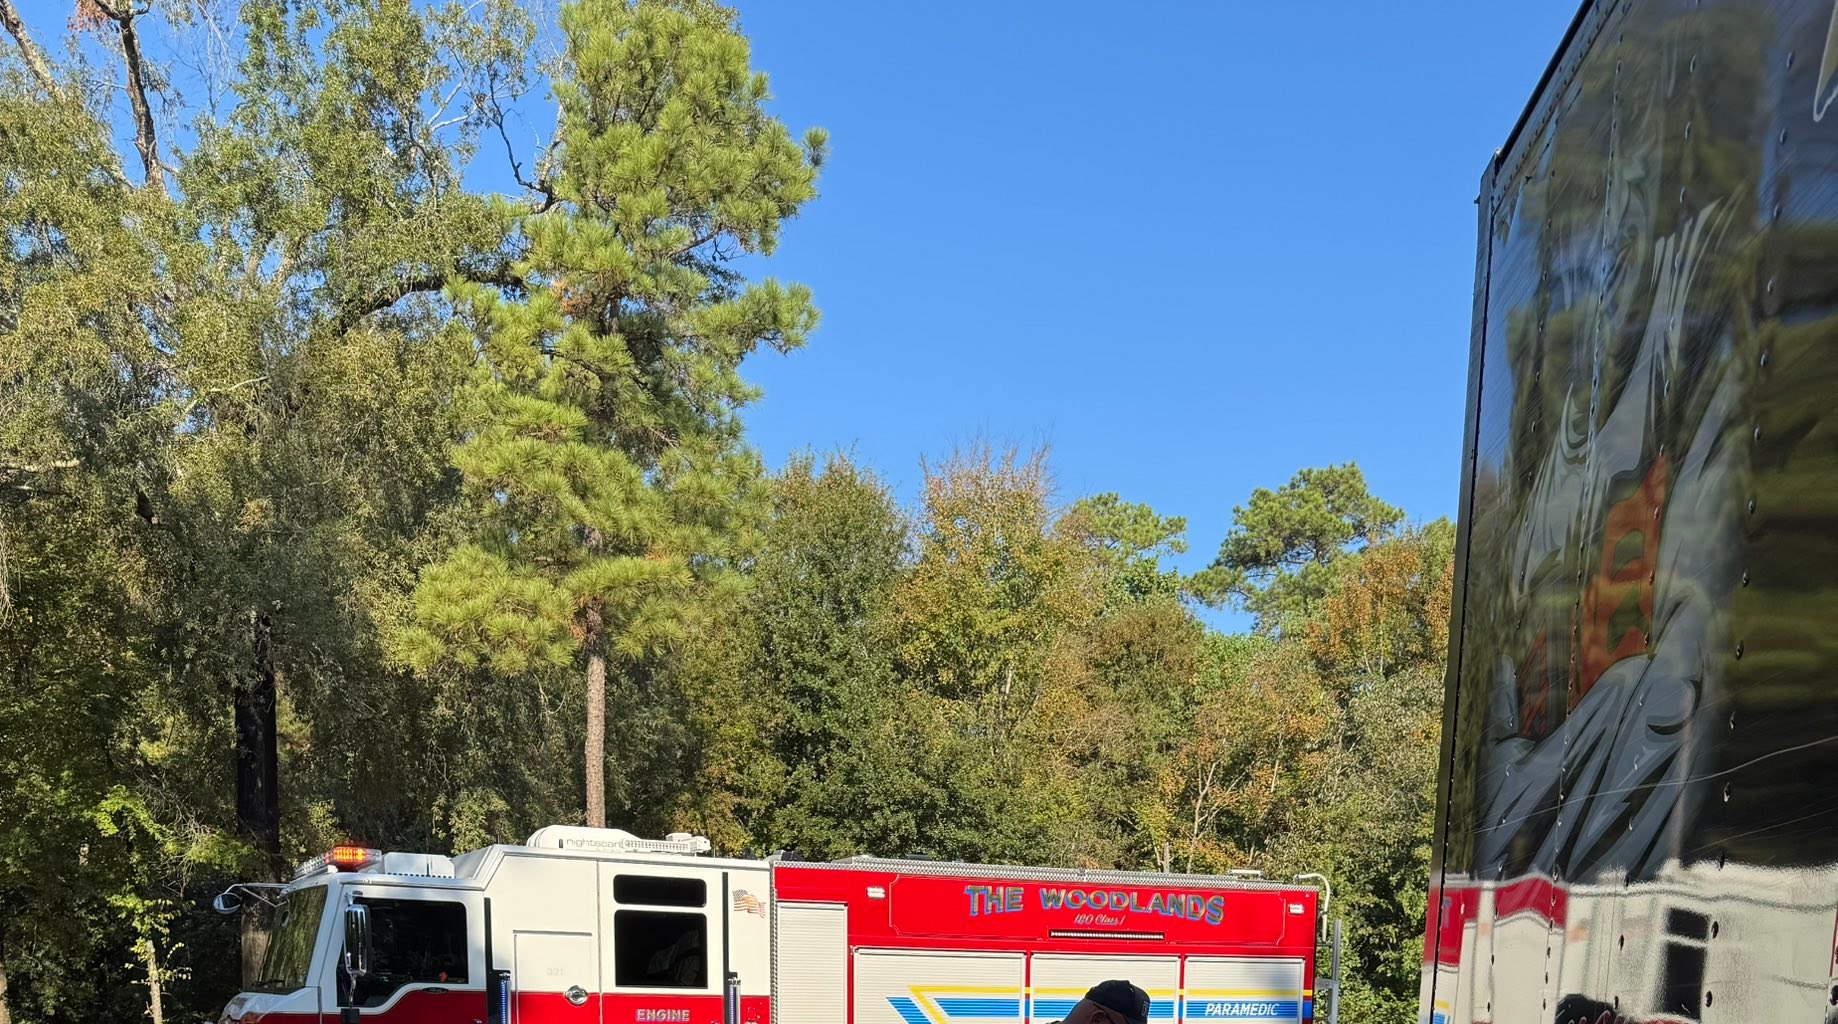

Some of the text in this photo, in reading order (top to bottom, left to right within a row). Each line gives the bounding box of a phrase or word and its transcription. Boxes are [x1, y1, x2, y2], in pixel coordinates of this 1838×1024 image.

[965, 885, 1225, 926] THE WOODLANDS
[635, 1008, 690, 1022] ENGINE
[1205, 1002, 1280, 1017] PARAMEDIC
